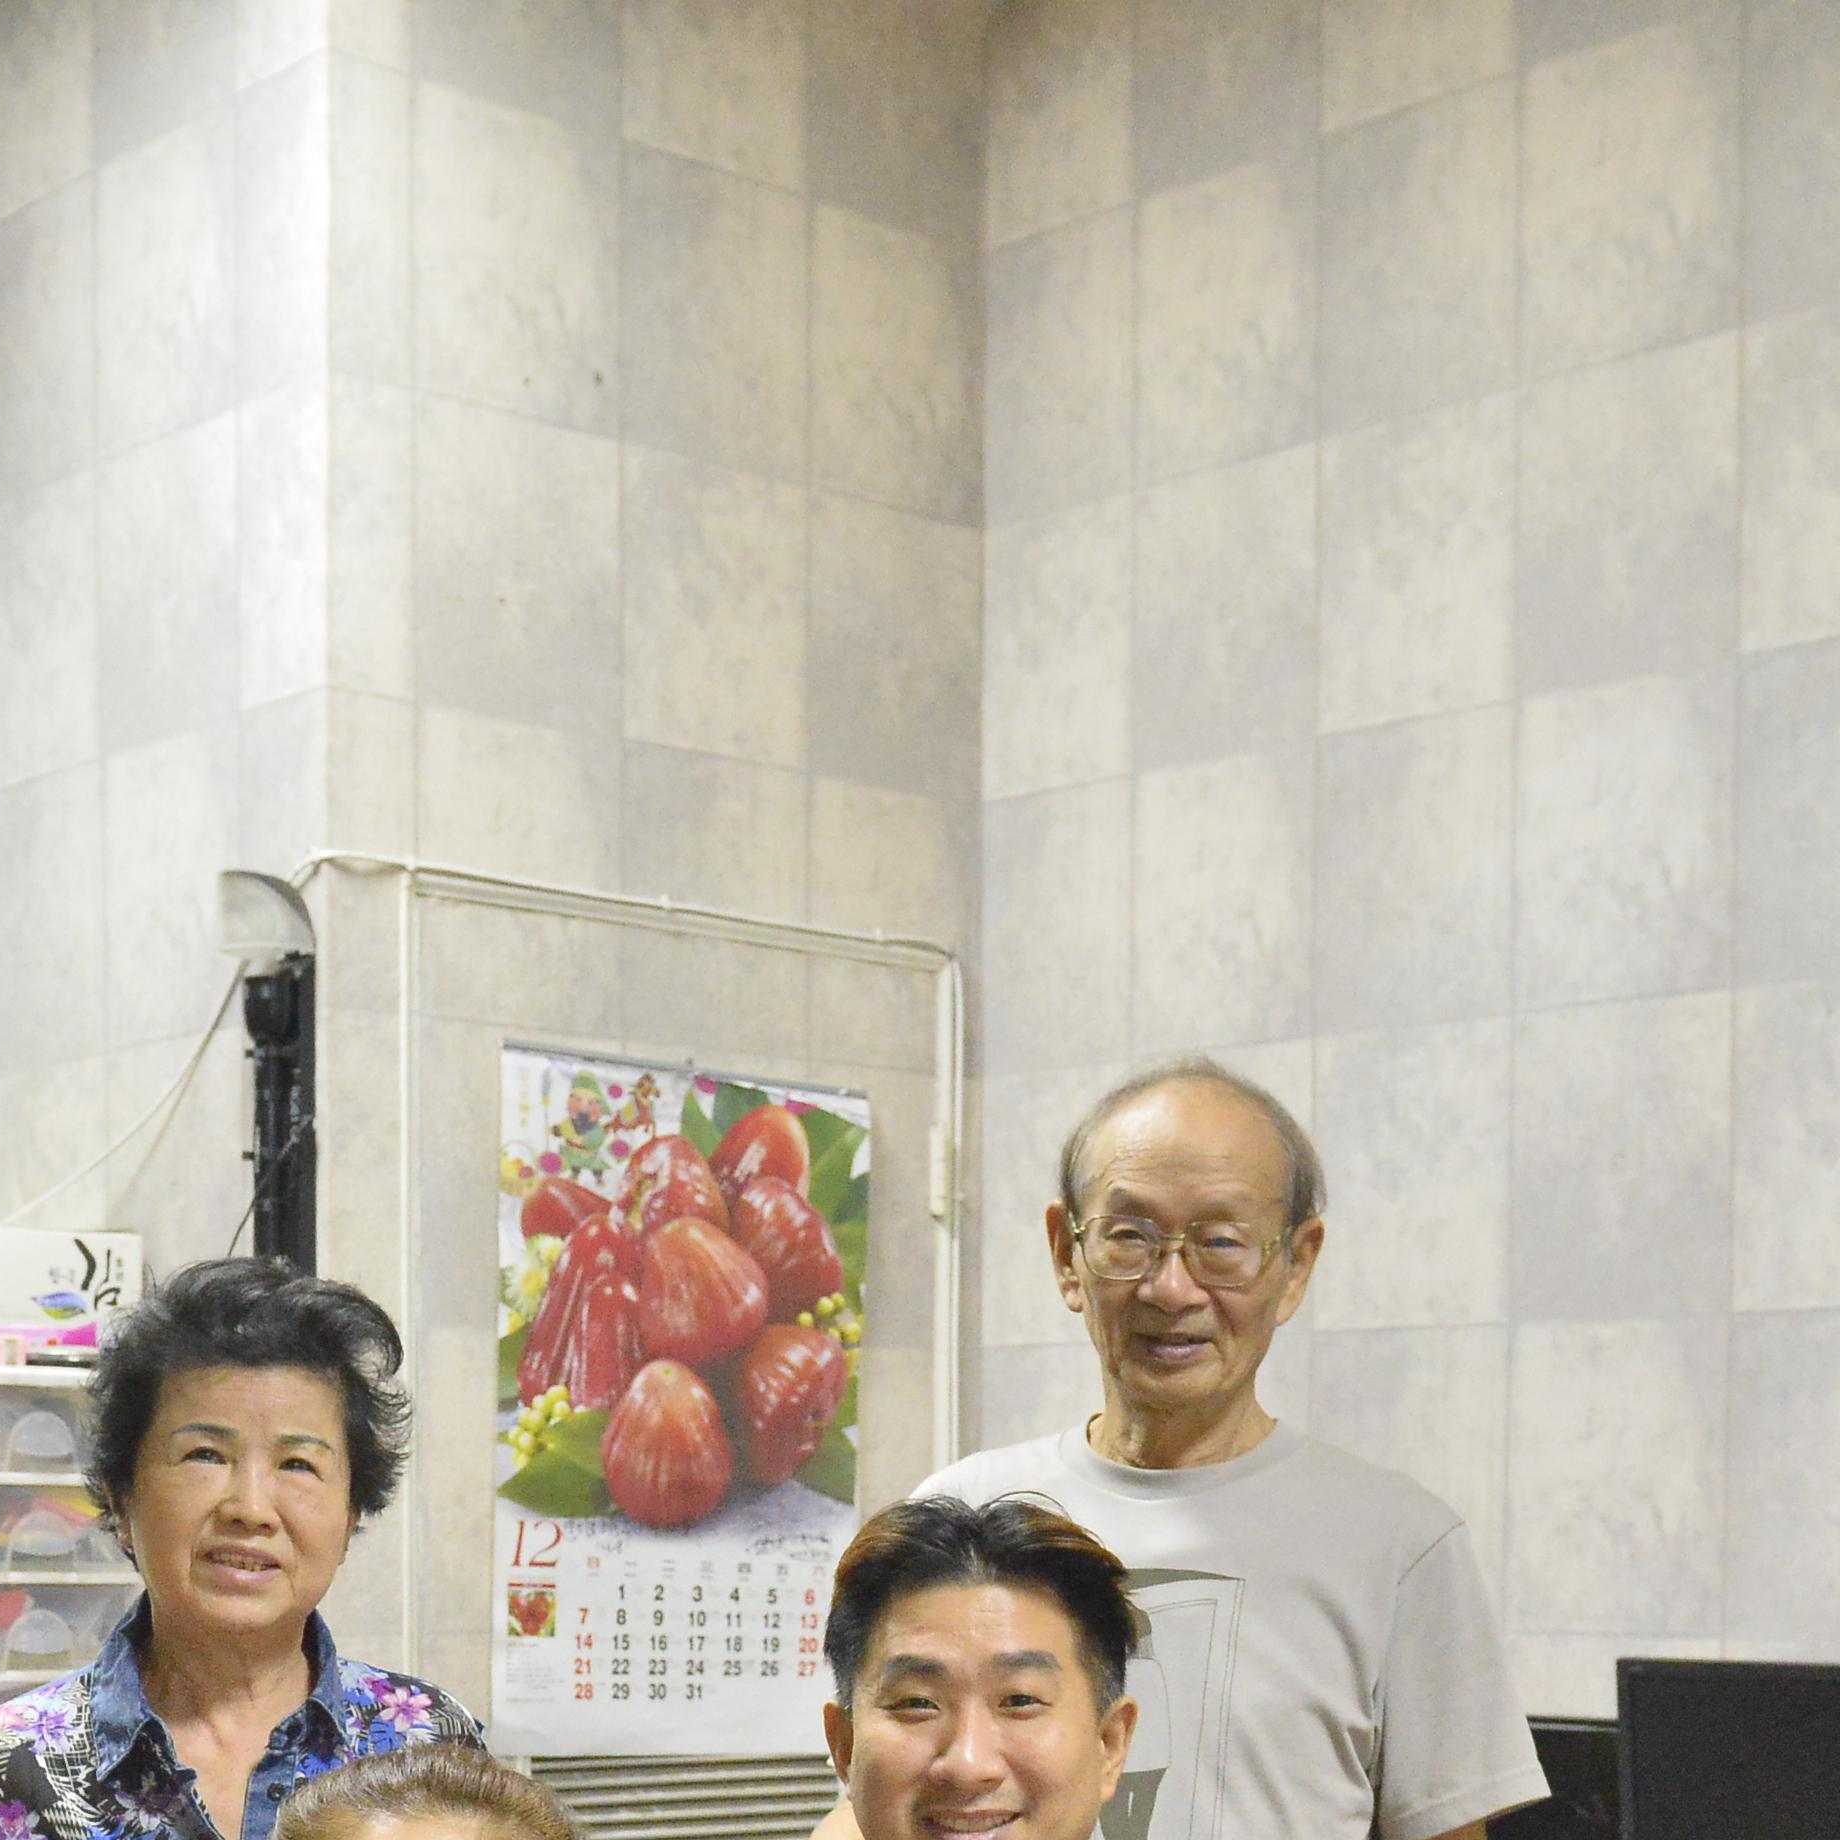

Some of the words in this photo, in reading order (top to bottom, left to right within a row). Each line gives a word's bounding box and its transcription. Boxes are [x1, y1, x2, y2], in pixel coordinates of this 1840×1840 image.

[510, 1520, 561, 1567] 12
[619, 1585, 624, 1599] 1
[655, 1585, 664, 1601] 2
[693, 1585, 702, 1602] 3
[730, 1588, 740, 1602] 4
[768, 1588, 777, 1604] 5
[804, 1589, 815, 1605] 6
[579, 1608, 588, 1624] 7
[617, 1609, 626, 1625] 8
[653, 1609, 664, 1626] 9
[689, 1610, 706, 1627] 10
[726, 1613, 741, 1627] 11
[763, 1613, 781, 1628] 12
[801, 1613, 818, 1630] 13
[576, 1634, 593, 1649] 14
[613, 1634, 630, 1651] 15
[650, 1634, 667, 1651] 16
[689, 1635, 705, 1651] 17
[726, 1636, 742, 1652] 18
[763, 1637, 780, 1653] 19
[800, 1637, 818, 1653] 20
[575, 1658, 591, 1675] 21
[612, 1659, 630, 1675] 22
[649, 1659, 666, 1676] 23
[687, 1660, 704, 1675] 24
[724, 1660, 742, 1676] 25
[761, 1660, 779, 1676] 26
[798, 1660, 817, 1677] 27
[575, 1683, 593, 1700] 28
[612, 1683, 630, 1700] 29
[649, 1683, 666, 1700] 30
[686, 1683, 702, 1700] 31
